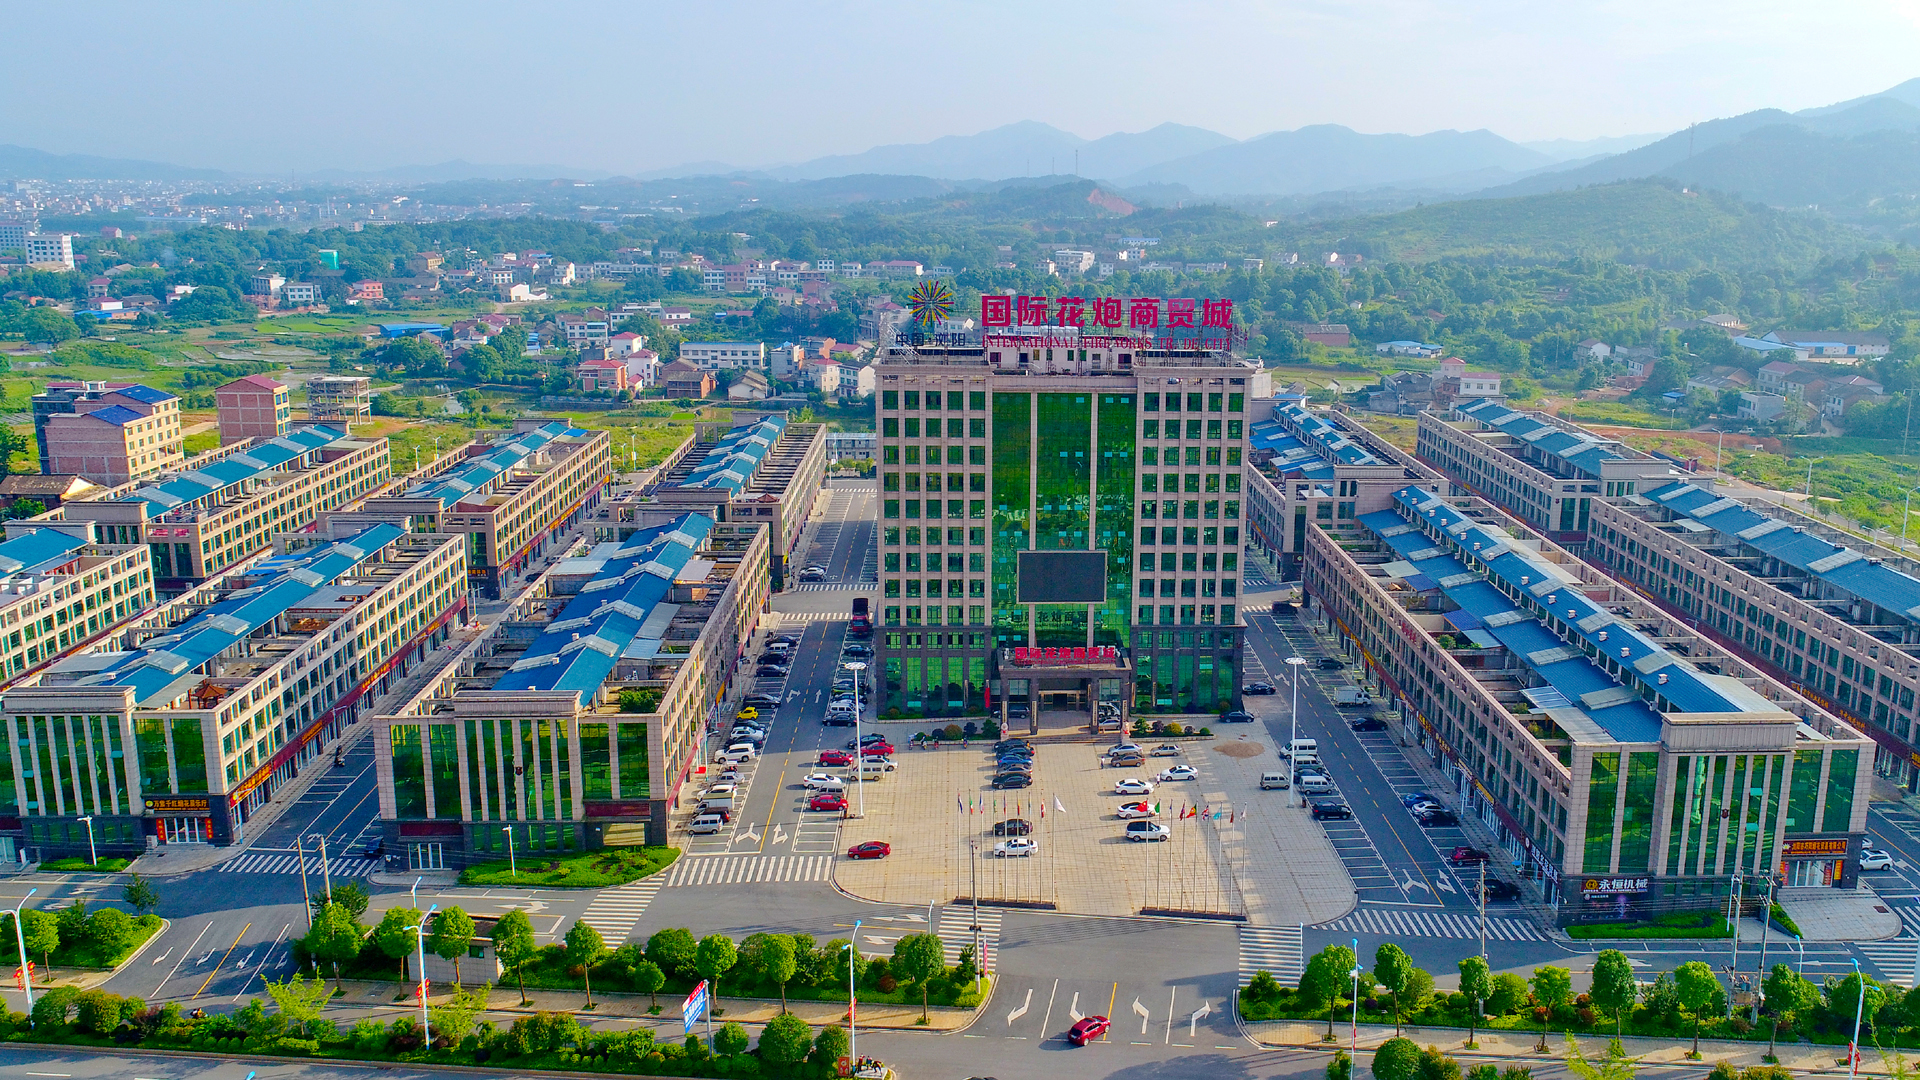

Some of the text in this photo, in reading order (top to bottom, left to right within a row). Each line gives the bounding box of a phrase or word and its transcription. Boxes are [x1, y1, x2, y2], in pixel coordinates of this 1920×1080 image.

[982, 295, 1233, 328] 国际花炮商贸城
[982, 335, 1077, 348] INTERNATIONAL
[1205, 337, 1233, 351] CITY
[1014, 647, 1116, 659] 国际花炮商贸城
[1599, 878, 1649, 890] 永恒机械
